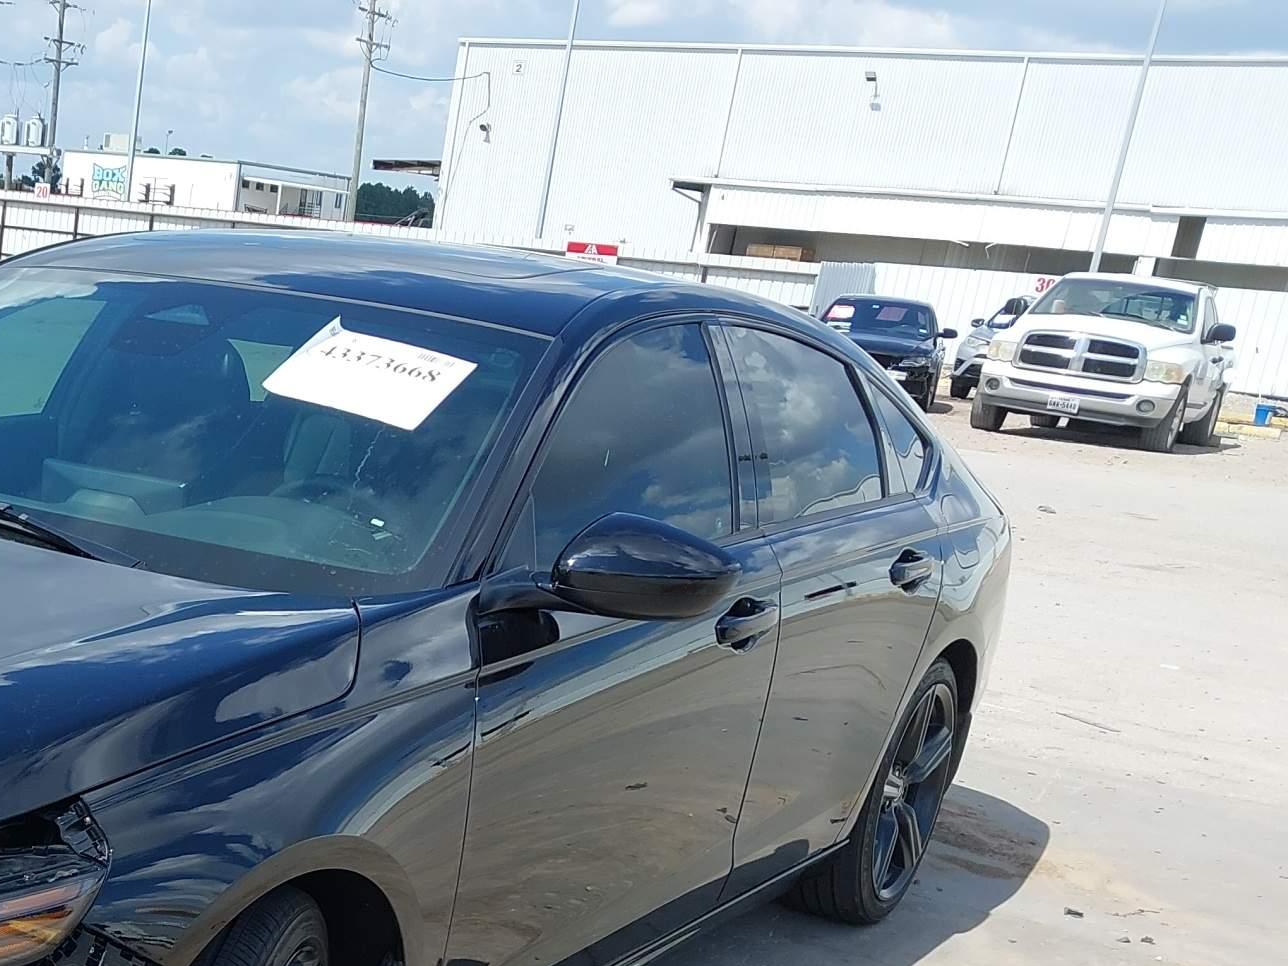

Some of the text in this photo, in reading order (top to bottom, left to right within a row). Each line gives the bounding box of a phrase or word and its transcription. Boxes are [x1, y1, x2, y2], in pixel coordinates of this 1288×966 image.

[515, 63, 523, 73] 2
[92, 163, 127, 182] BOX
[36, 185, 49, 199] 20
[92, 180, 125, 196] GANG
[320, 345, 441, 382] 43373668
